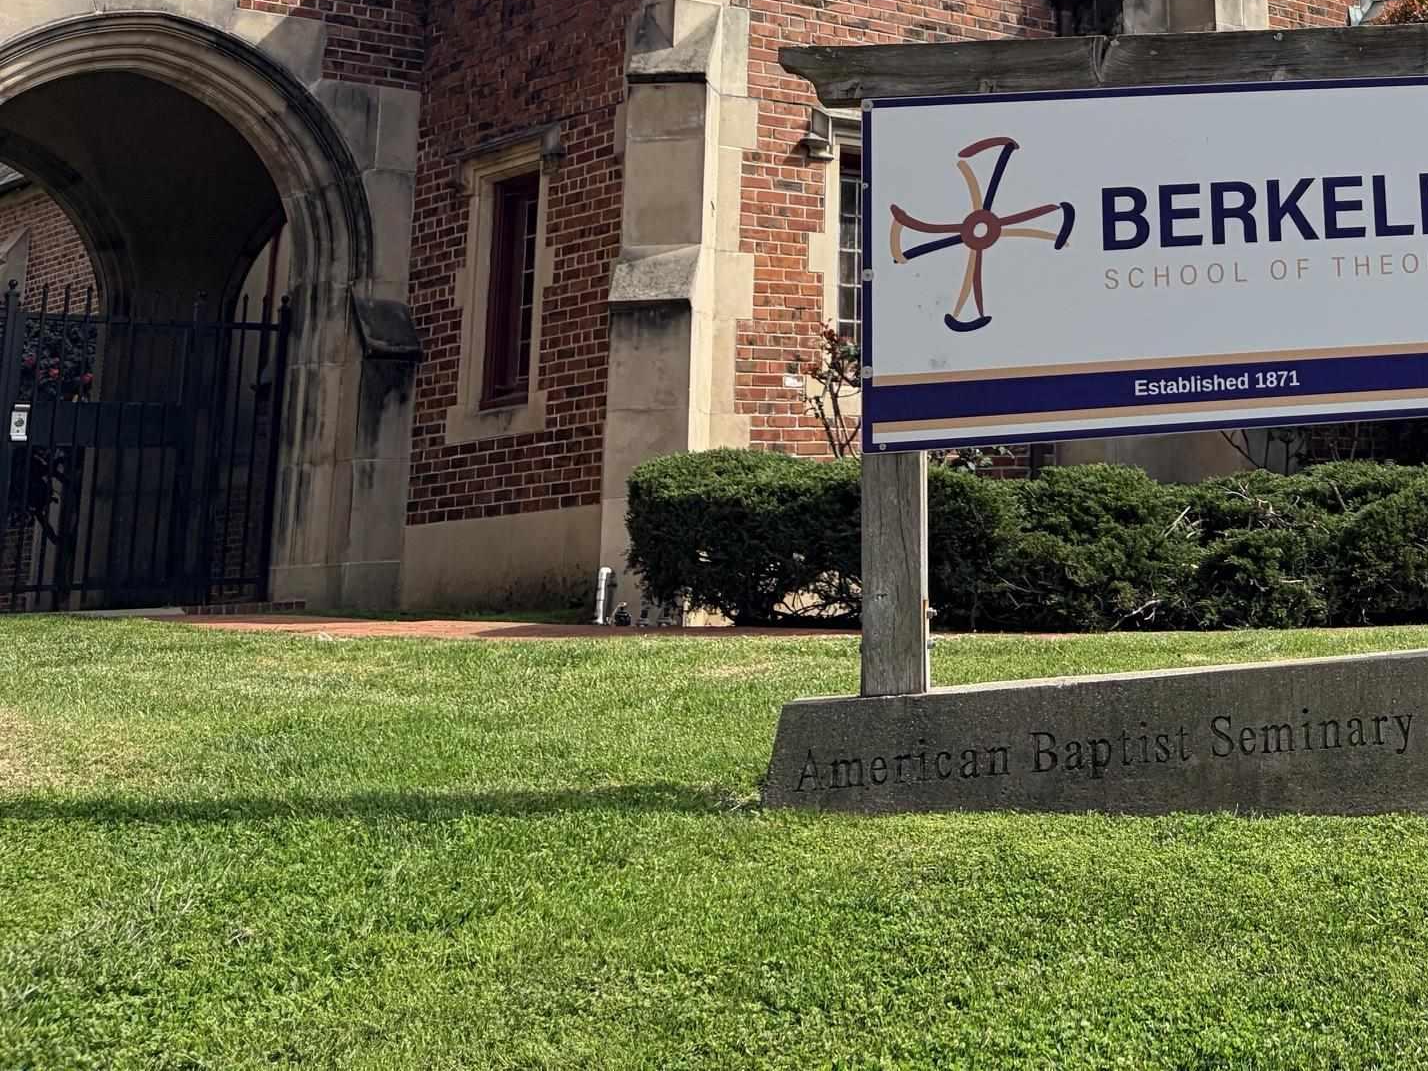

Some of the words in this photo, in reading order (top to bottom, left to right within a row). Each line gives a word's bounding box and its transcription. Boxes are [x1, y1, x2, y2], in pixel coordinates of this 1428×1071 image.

[1104, 261, 1248, 289] SCHOOL
[1270, 258, 1310, 280] OF
[1134, 373, 1249, 396] Established
[1255, 370, 1300, 388] 1871
[794, 738, 1010, 792] American
[1029, 722, 1194, 779] Baptist
[1210, 707, 1414, 758] Seminary
